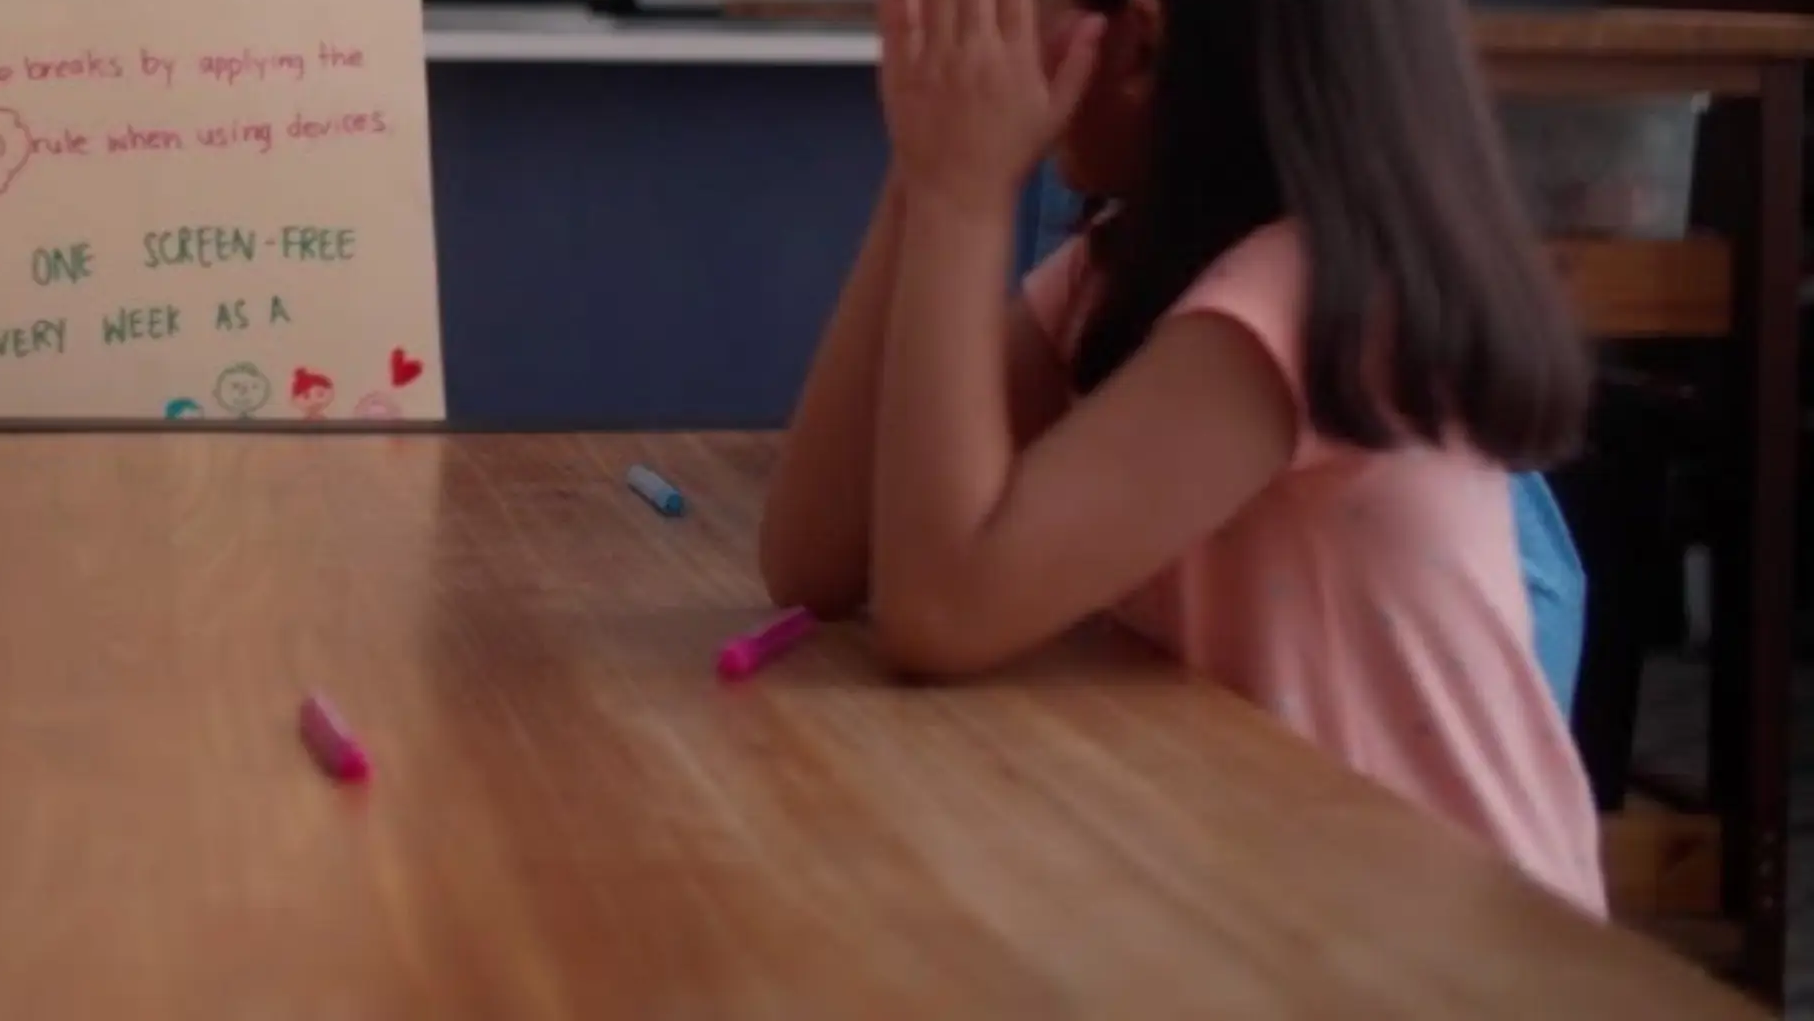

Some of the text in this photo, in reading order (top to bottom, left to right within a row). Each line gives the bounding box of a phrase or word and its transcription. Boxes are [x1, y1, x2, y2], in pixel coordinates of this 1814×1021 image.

[23, 50, 124, 79] breaks
[140, 47, 175, 89] by
[198, 47, 305, 86] applying
[318, 40, 365, 69] the
[32, 127, 88, 156] rule
[107, 124, 183, 155] when
[196, 118, 272, 154] using
[32, 242, 94, 286] ONE
[143, 226, 356, 269] SCREEN-FREE
[102, 305, 182, 346] WEEK
[216, 298, 250, 331] AS
[269, 294, 291, 324] A
